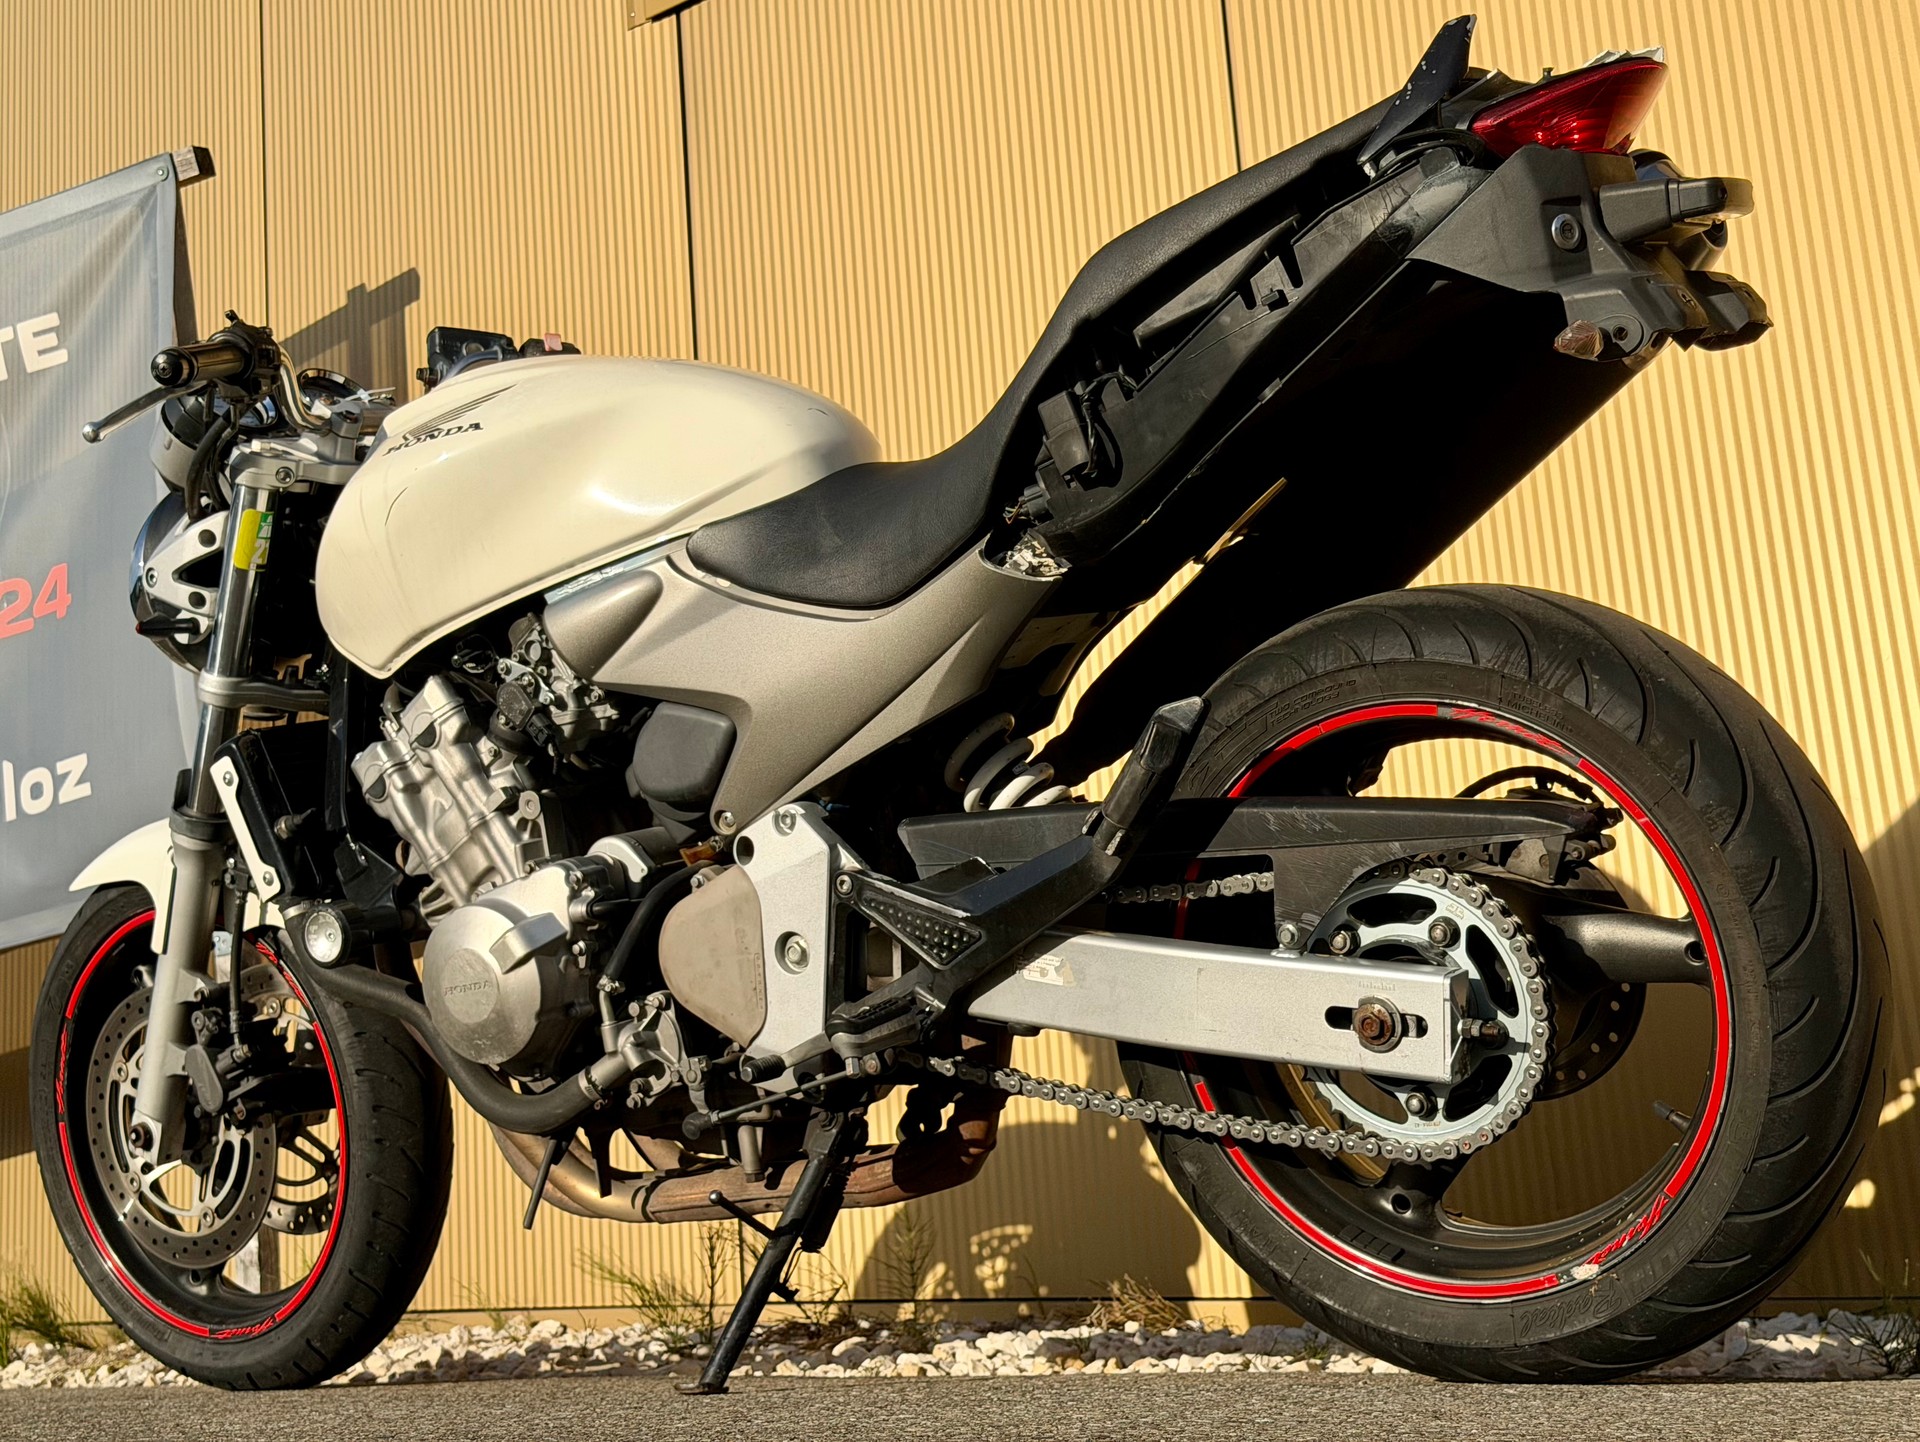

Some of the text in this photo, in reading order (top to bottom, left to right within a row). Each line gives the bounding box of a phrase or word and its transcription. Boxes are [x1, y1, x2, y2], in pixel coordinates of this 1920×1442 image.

[382, 422, 484, 456] HONDA
[0, 562, 72, 639] 24
[443, 980, 490, 997] HONDA
[1519, 1278, 1622, 1338] Radial
